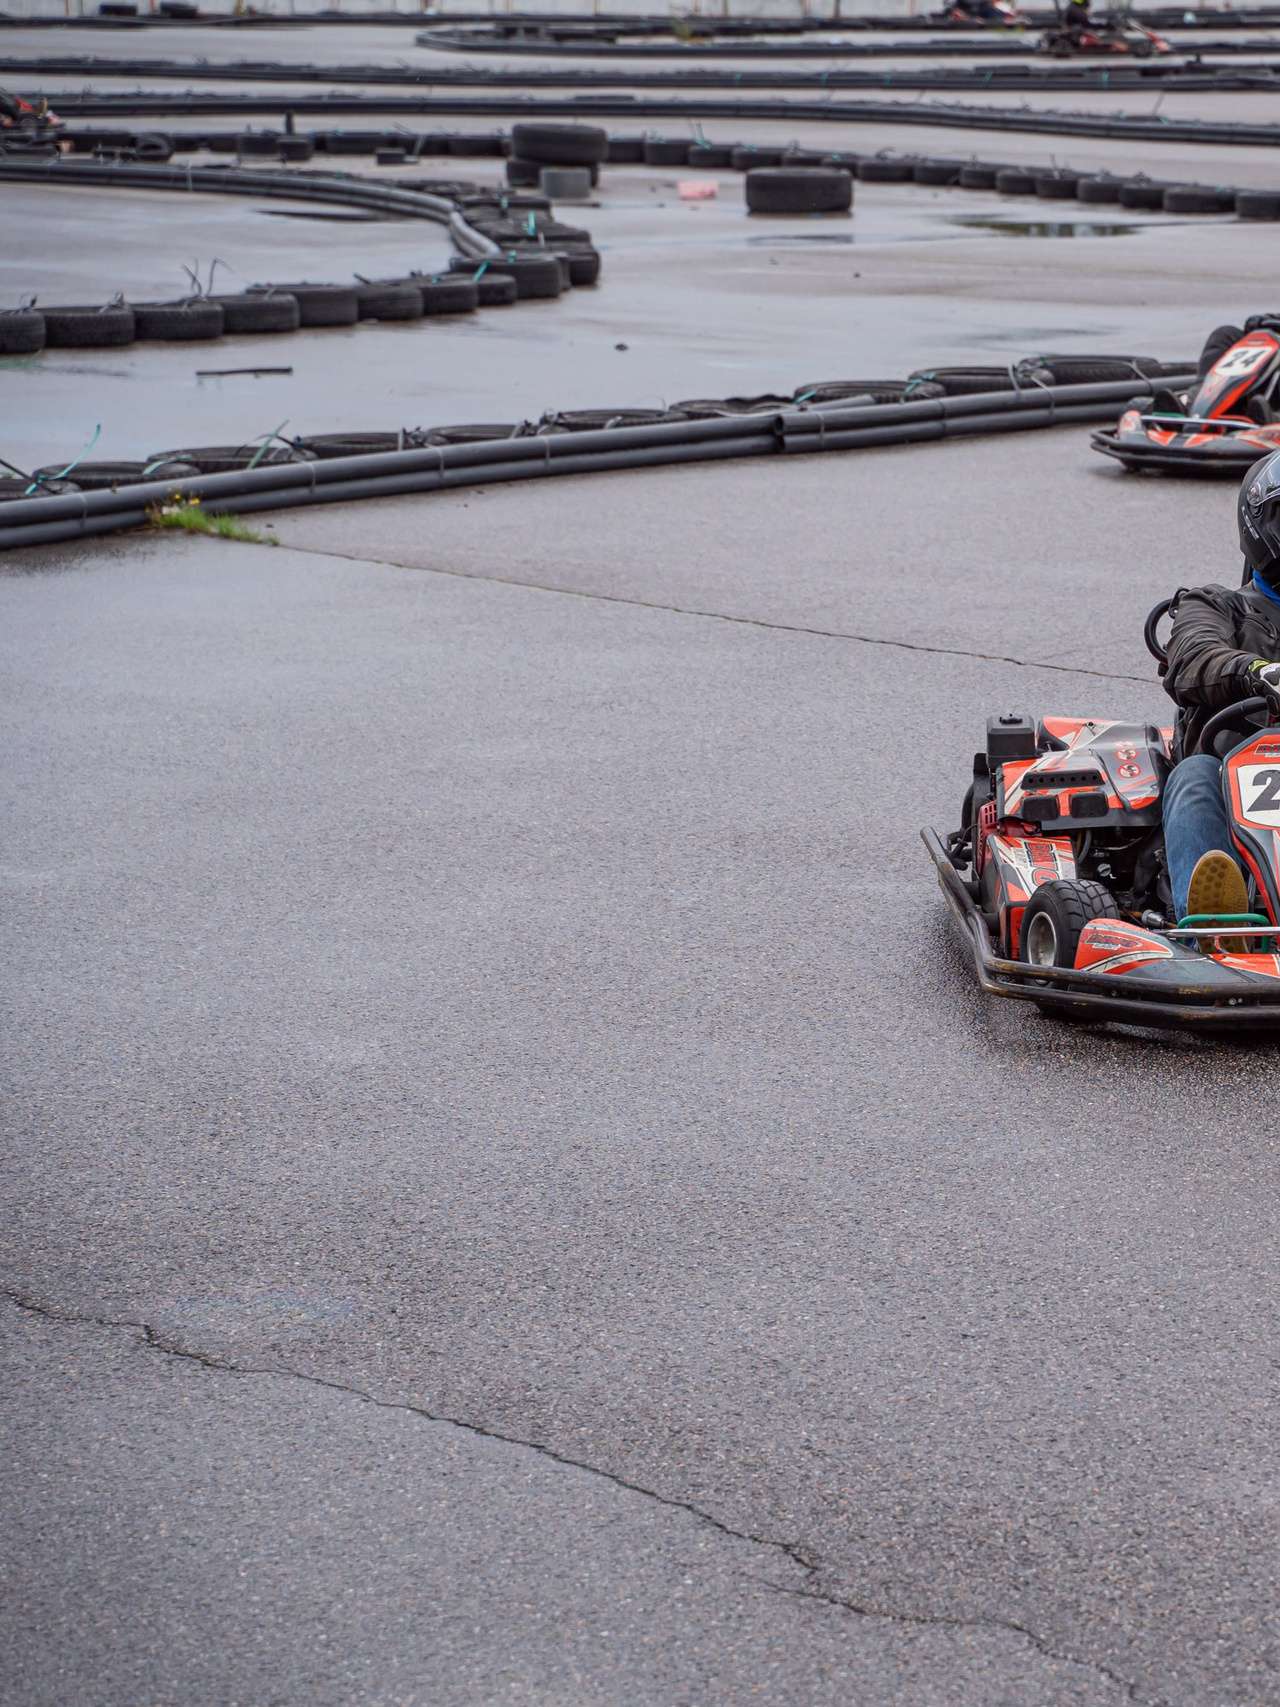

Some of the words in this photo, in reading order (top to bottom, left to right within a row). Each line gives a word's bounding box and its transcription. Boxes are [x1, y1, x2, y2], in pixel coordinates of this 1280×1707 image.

[1221, 349, 1267, 369] 24
[1024, 841, 1061, 888] DINO
[1085, 933, 1140, 949] DINO
